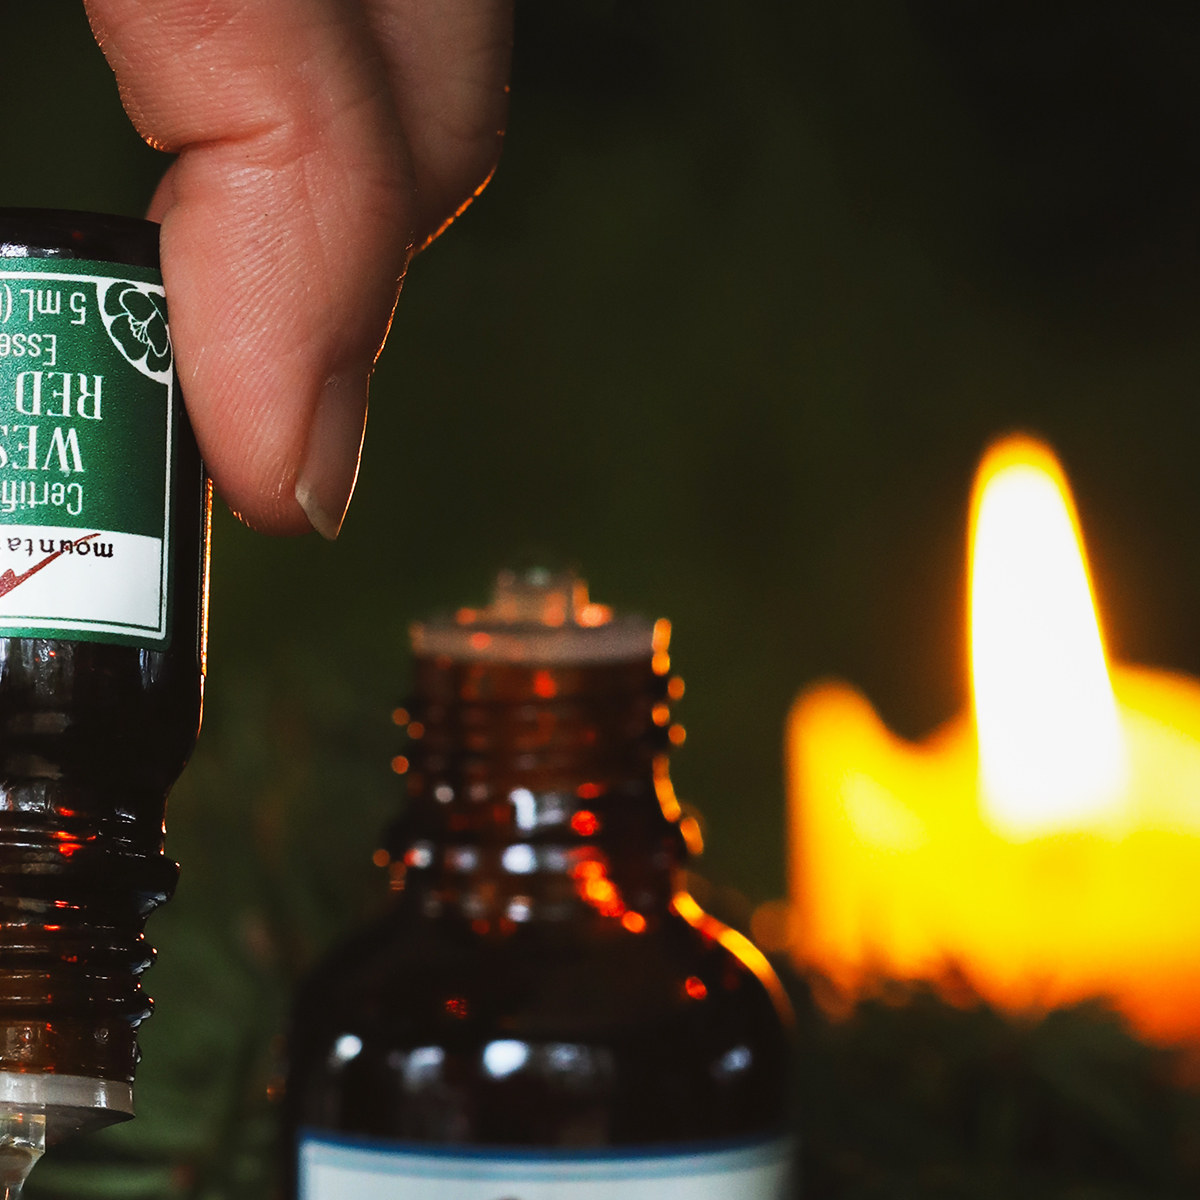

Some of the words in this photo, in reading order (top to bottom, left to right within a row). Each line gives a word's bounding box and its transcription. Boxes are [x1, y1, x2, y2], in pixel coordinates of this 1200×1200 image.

[28, 289, 61, 322] mL
[70, 291, 86, 325] 5
[15, 371, 104, 420] RED
